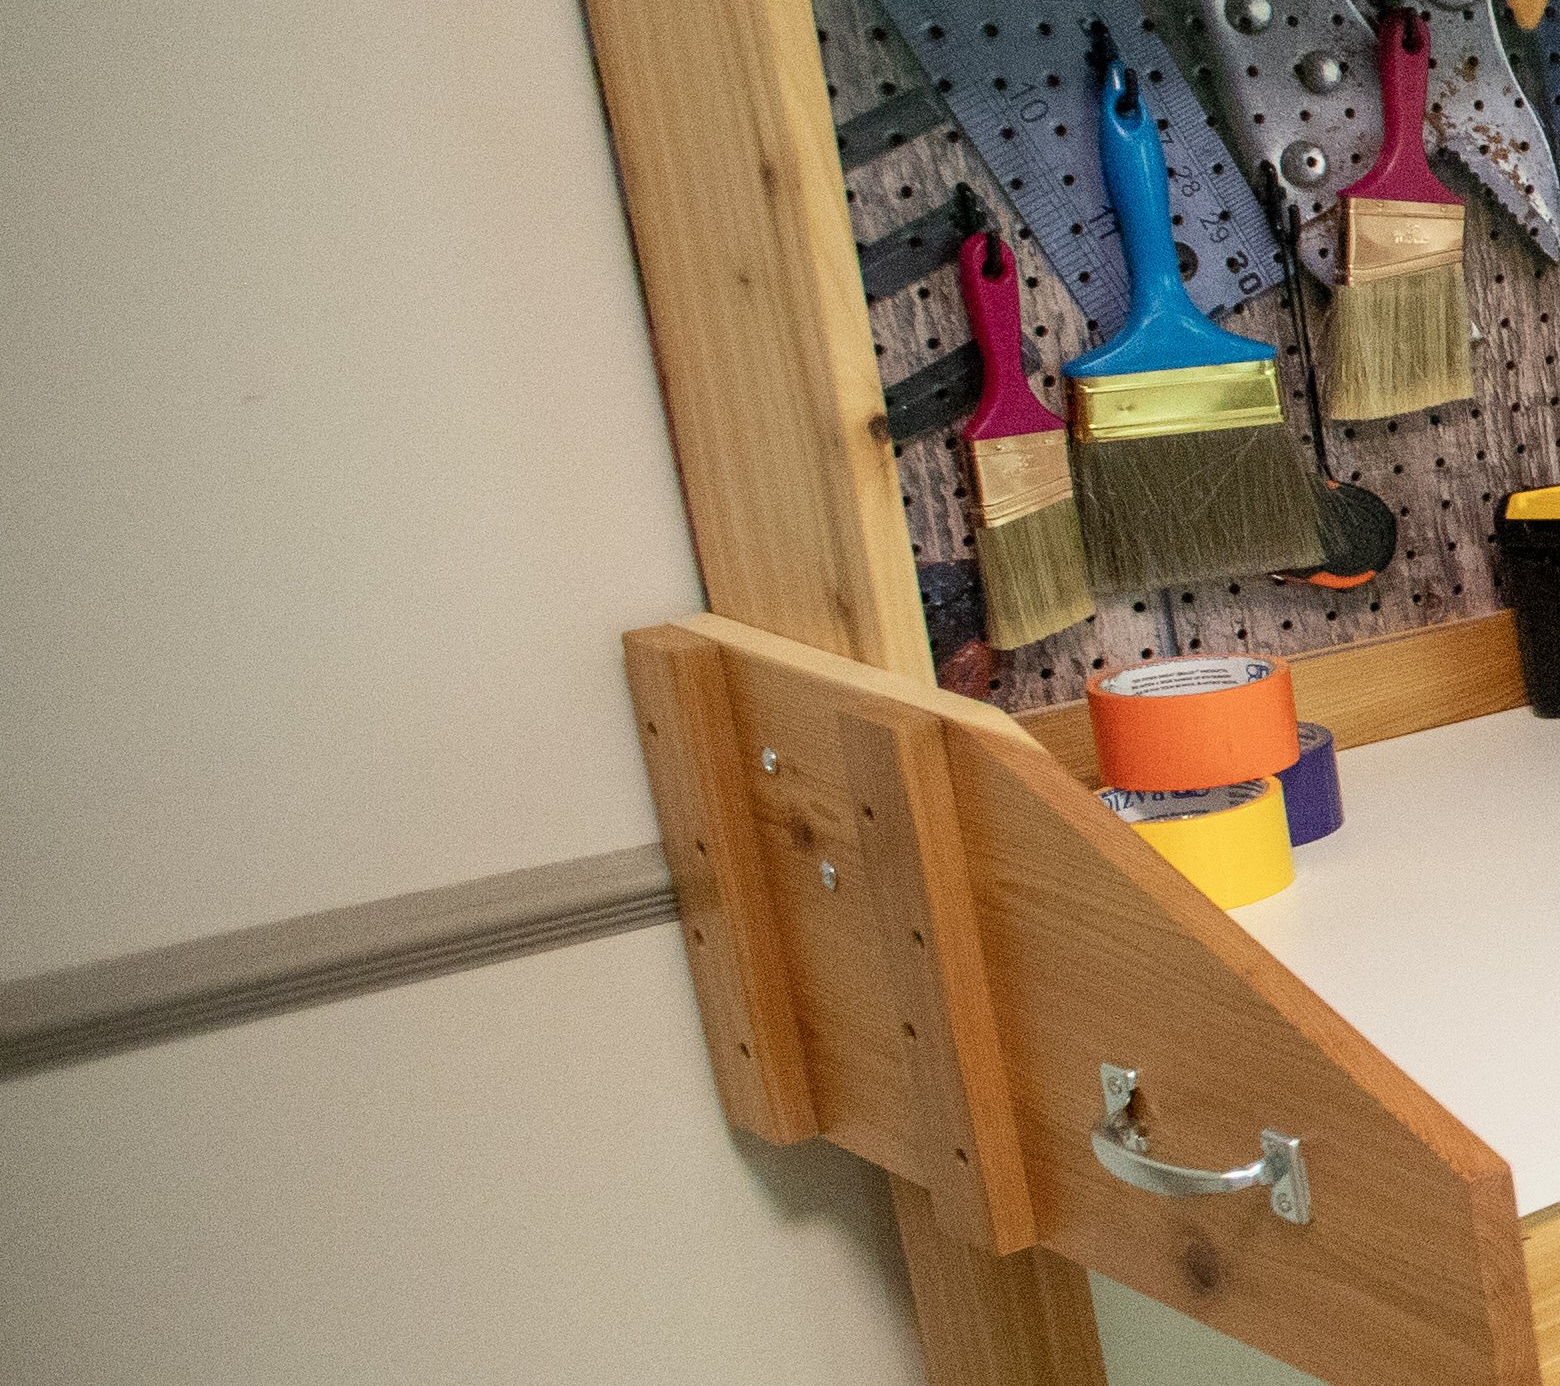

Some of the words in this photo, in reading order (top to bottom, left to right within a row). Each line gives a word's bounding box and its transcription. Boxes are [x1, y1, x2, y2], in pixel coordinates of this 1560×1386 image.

[1009, 83, 1048, 123] 10
[1173, 165, 1200, 198] 28
[1197, 213, 1229, 243] 29
